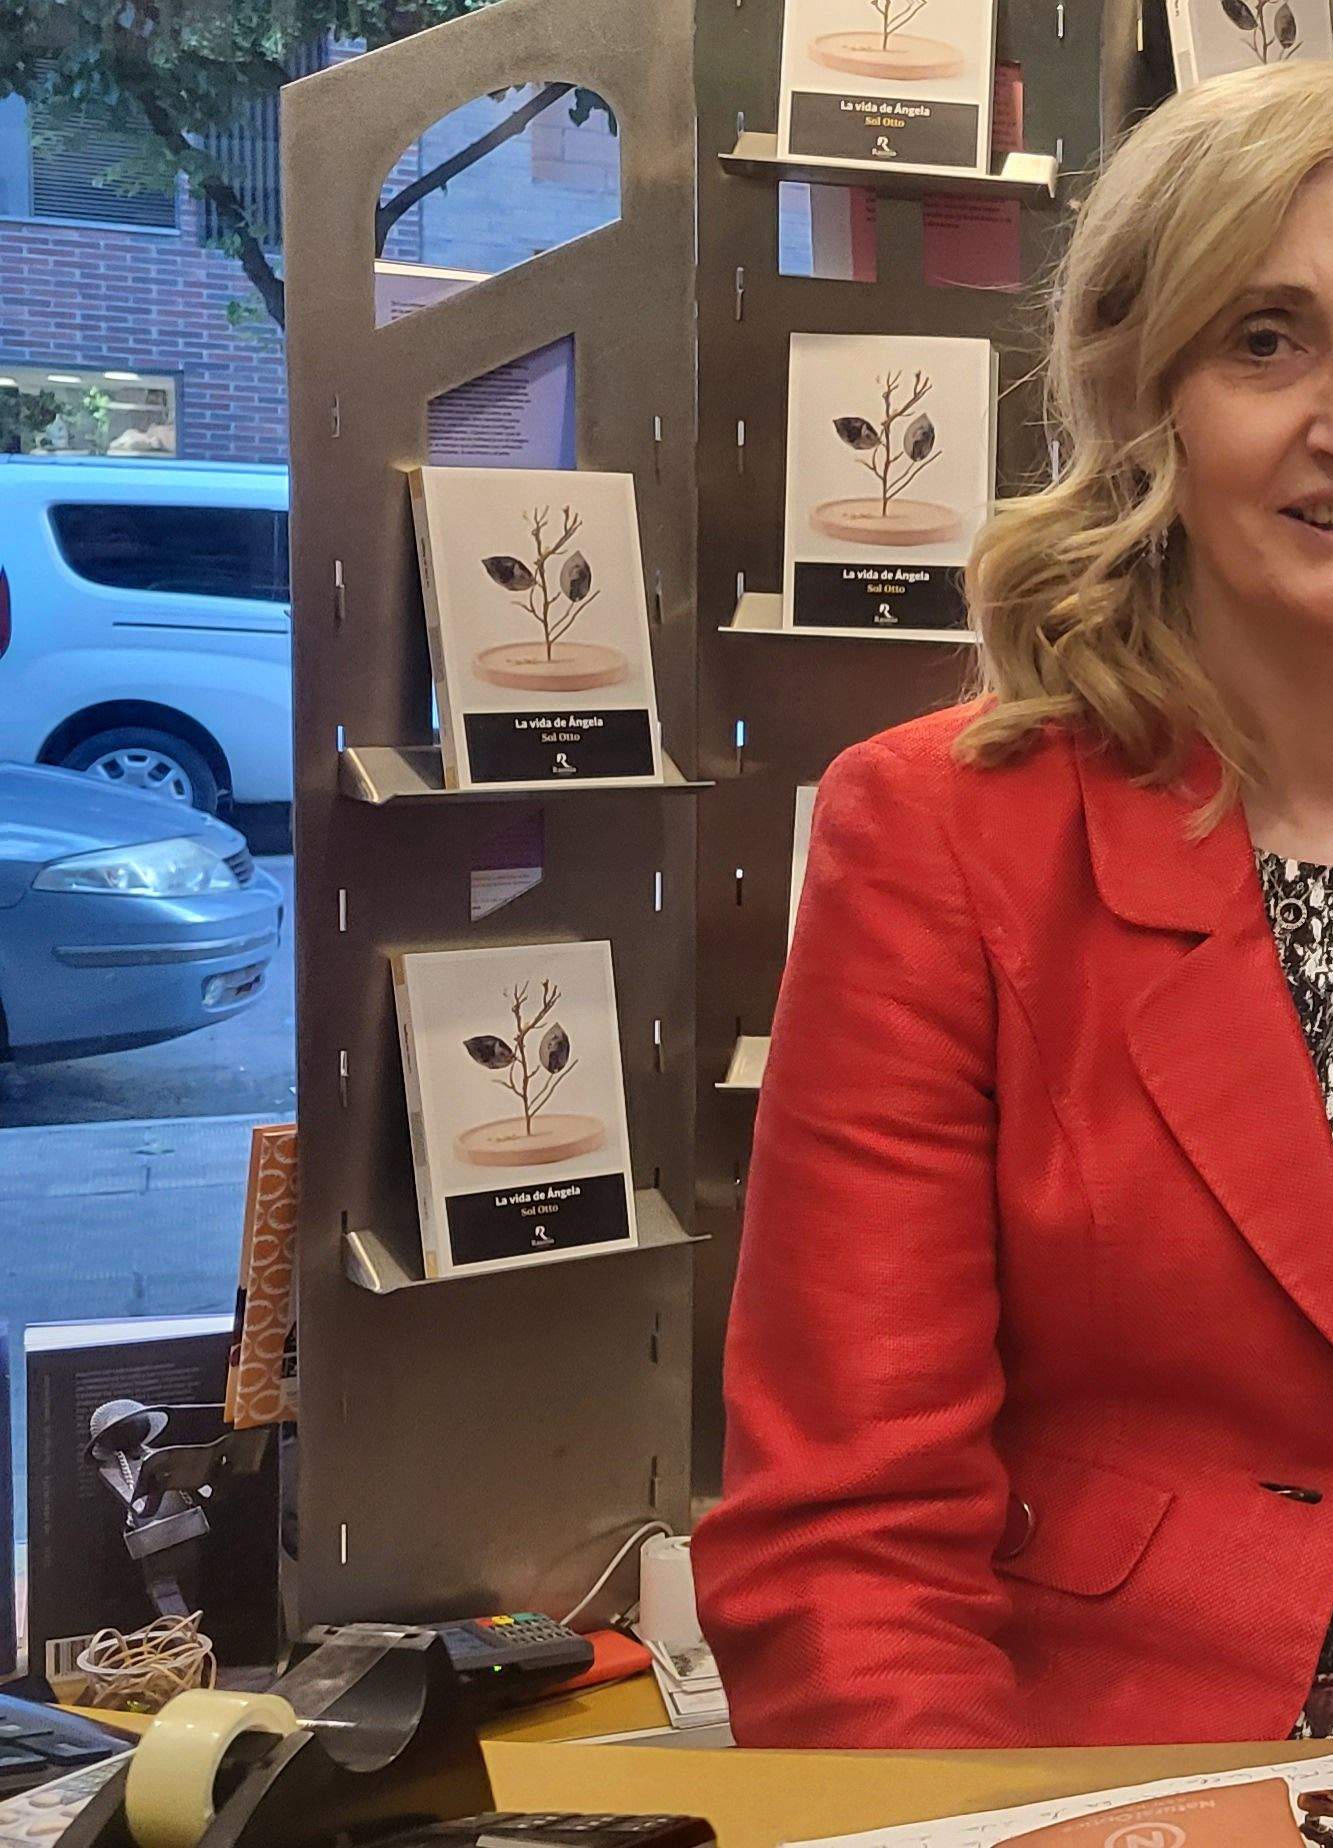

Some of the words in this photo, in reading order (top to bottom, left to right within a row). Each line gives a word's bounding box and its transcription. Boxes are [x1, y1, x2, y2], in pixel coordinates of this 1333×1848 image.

[840, 100, 853, 111] La
[855, 101, 878, 113] vida
[879, 103, 893, 114] de
[894, 102, 931, 117] Ángela
[864, 116, 881, 126] Sol
[882, 118, 905, 128] Otto
[842, 568, 855, 579] La
[857, 569, 879, 580] vida
[880, 570, 893, 580] de
[894, 568, 930, 583] Ángela
[866, 583, 883, 593] Sol
[883, 584, 906, 594] Otto
[515, 718, 528, 729] La
[529, 717, 552, 729] vida
[553, 717, 567, 728] de
[568, 715, 604, 729] Ángela
[541, 732, 557, 743] Sol
[558, 732, 581, 742] Otto
[495, 1196, 508, 1207] La
[509, 1191, 532, 1205] vida
[533, 1190, 546, 1201] de
[547, 1185, 581, 1201] Ángela
[520, 1206, 536, 1217] Sol
[537, 1203, 559, 1215] Otto
[1136, 1799, 1216, 1819] Natural
